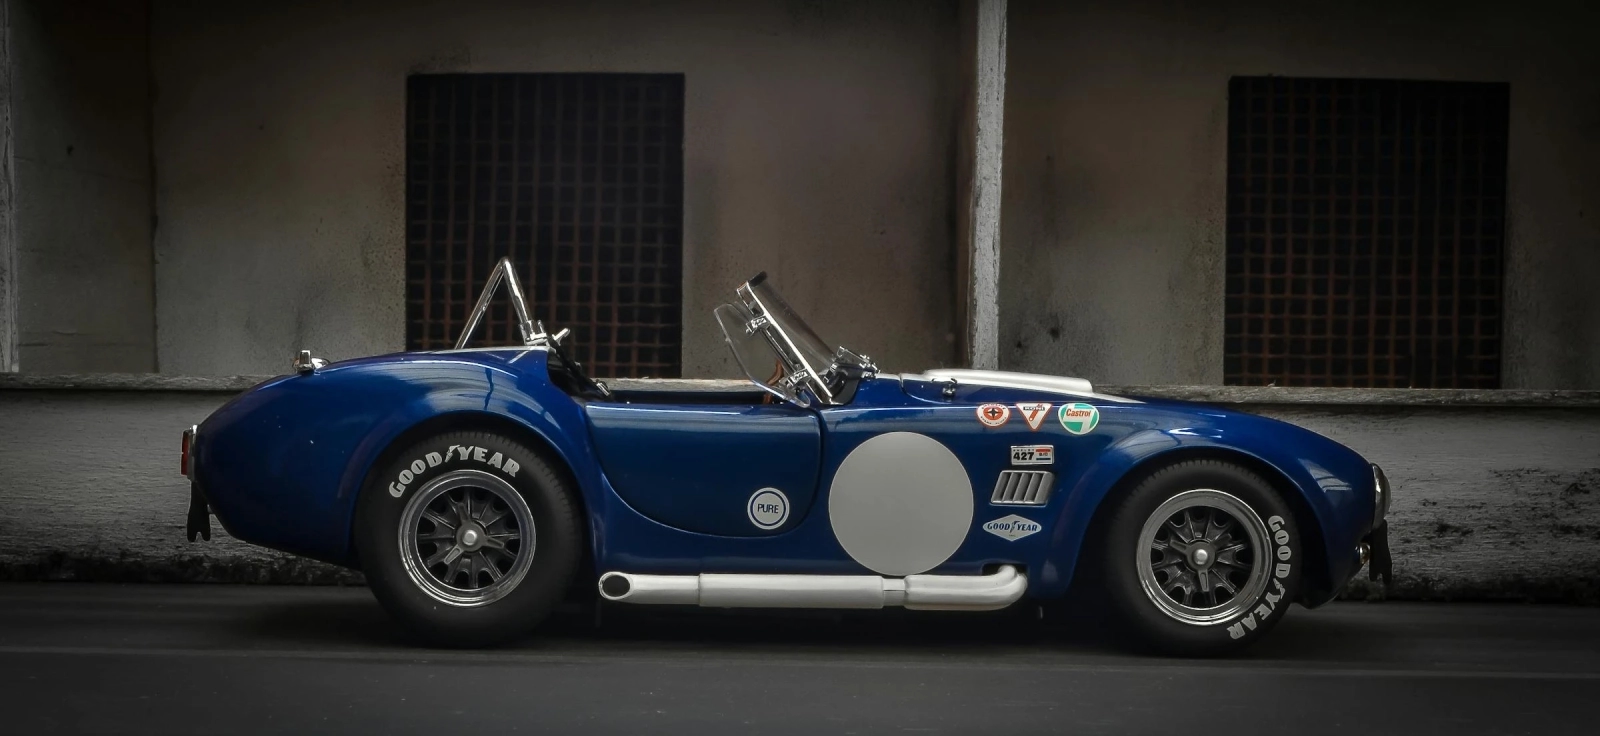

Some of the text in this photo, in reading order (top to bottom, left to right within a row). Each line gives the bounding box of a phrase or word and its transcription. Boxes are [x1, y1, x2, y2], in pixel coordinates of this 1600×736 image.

[1066, 409, 1091, 417] Castrol
[1013, 451, 1034, 461] 427
[757, 503, 779, 514] PURE
